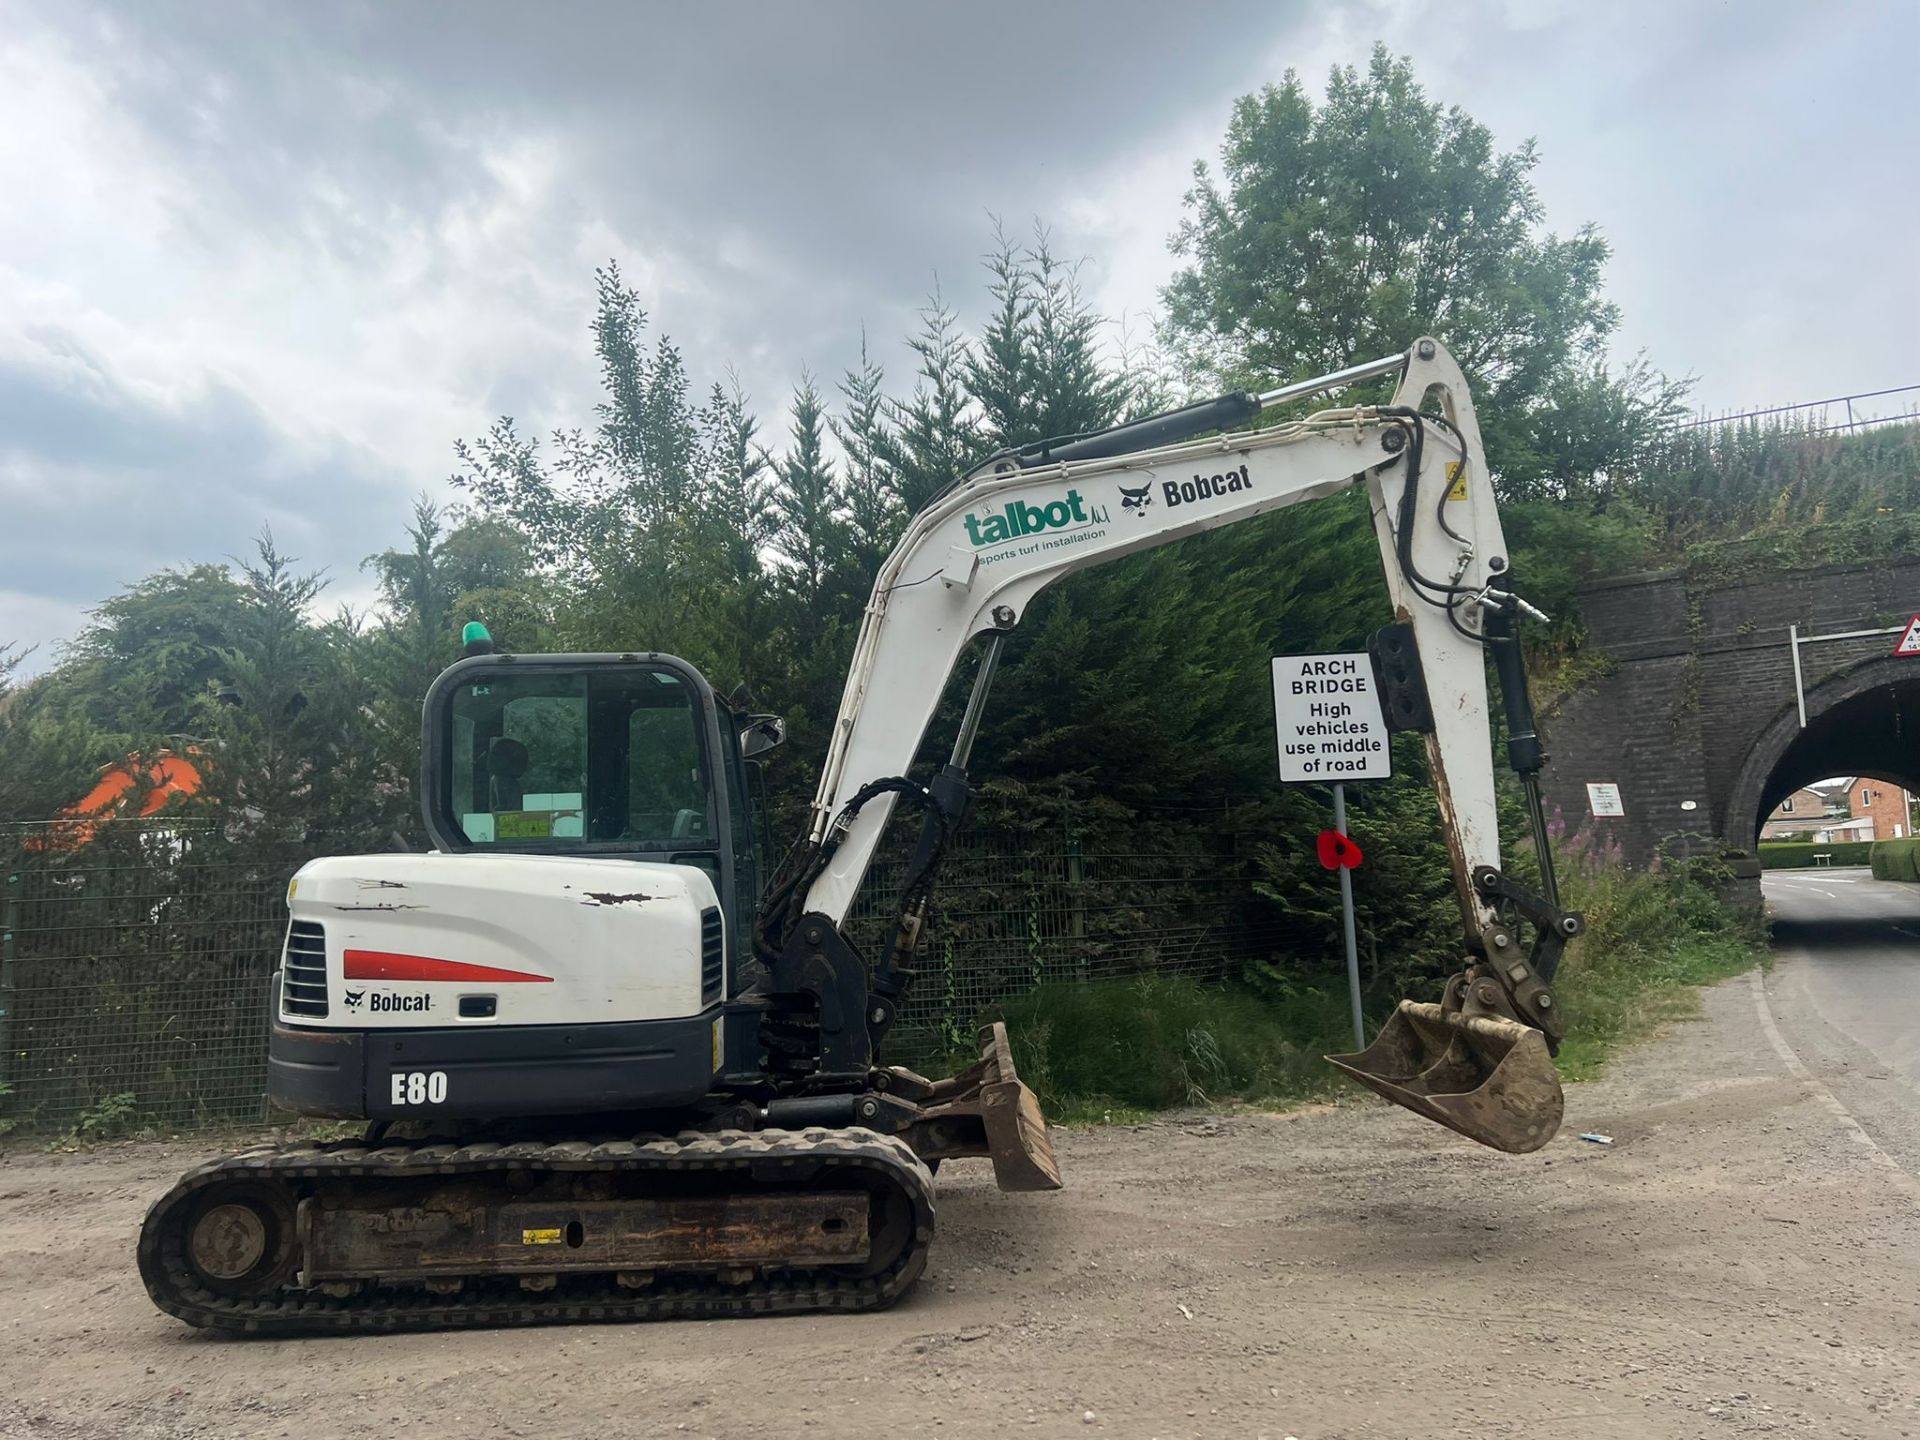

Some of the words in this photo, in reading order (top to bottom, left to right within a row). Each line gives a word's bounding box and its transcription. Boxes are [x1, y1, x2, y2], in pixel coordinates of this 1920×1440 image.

[1162, 464, 1252, 508] Bobcat
[964, 489, 1088, 546] talbot
[979, 550, 1017, 566] sports
[1018, 542, 1040, 556] turf
[1041, 529, 1106, 551] installation
[1301, 661, 1356, 676] ARCH
[1291, 678, 1367, 695] BRIDGE
[1310, 702, 1351, 719] High
[1295, 720, 1369, 736] vehicles
[1285, 743, 1316, 755] use
[1321, 738, 1382, 753] middle
[1303, 758, 1321, 773] of
[1326, 756, 1367, 772] road
[370, 993, 431, 1012] Bobcat
[391, 1071, 448, 1105] E80
